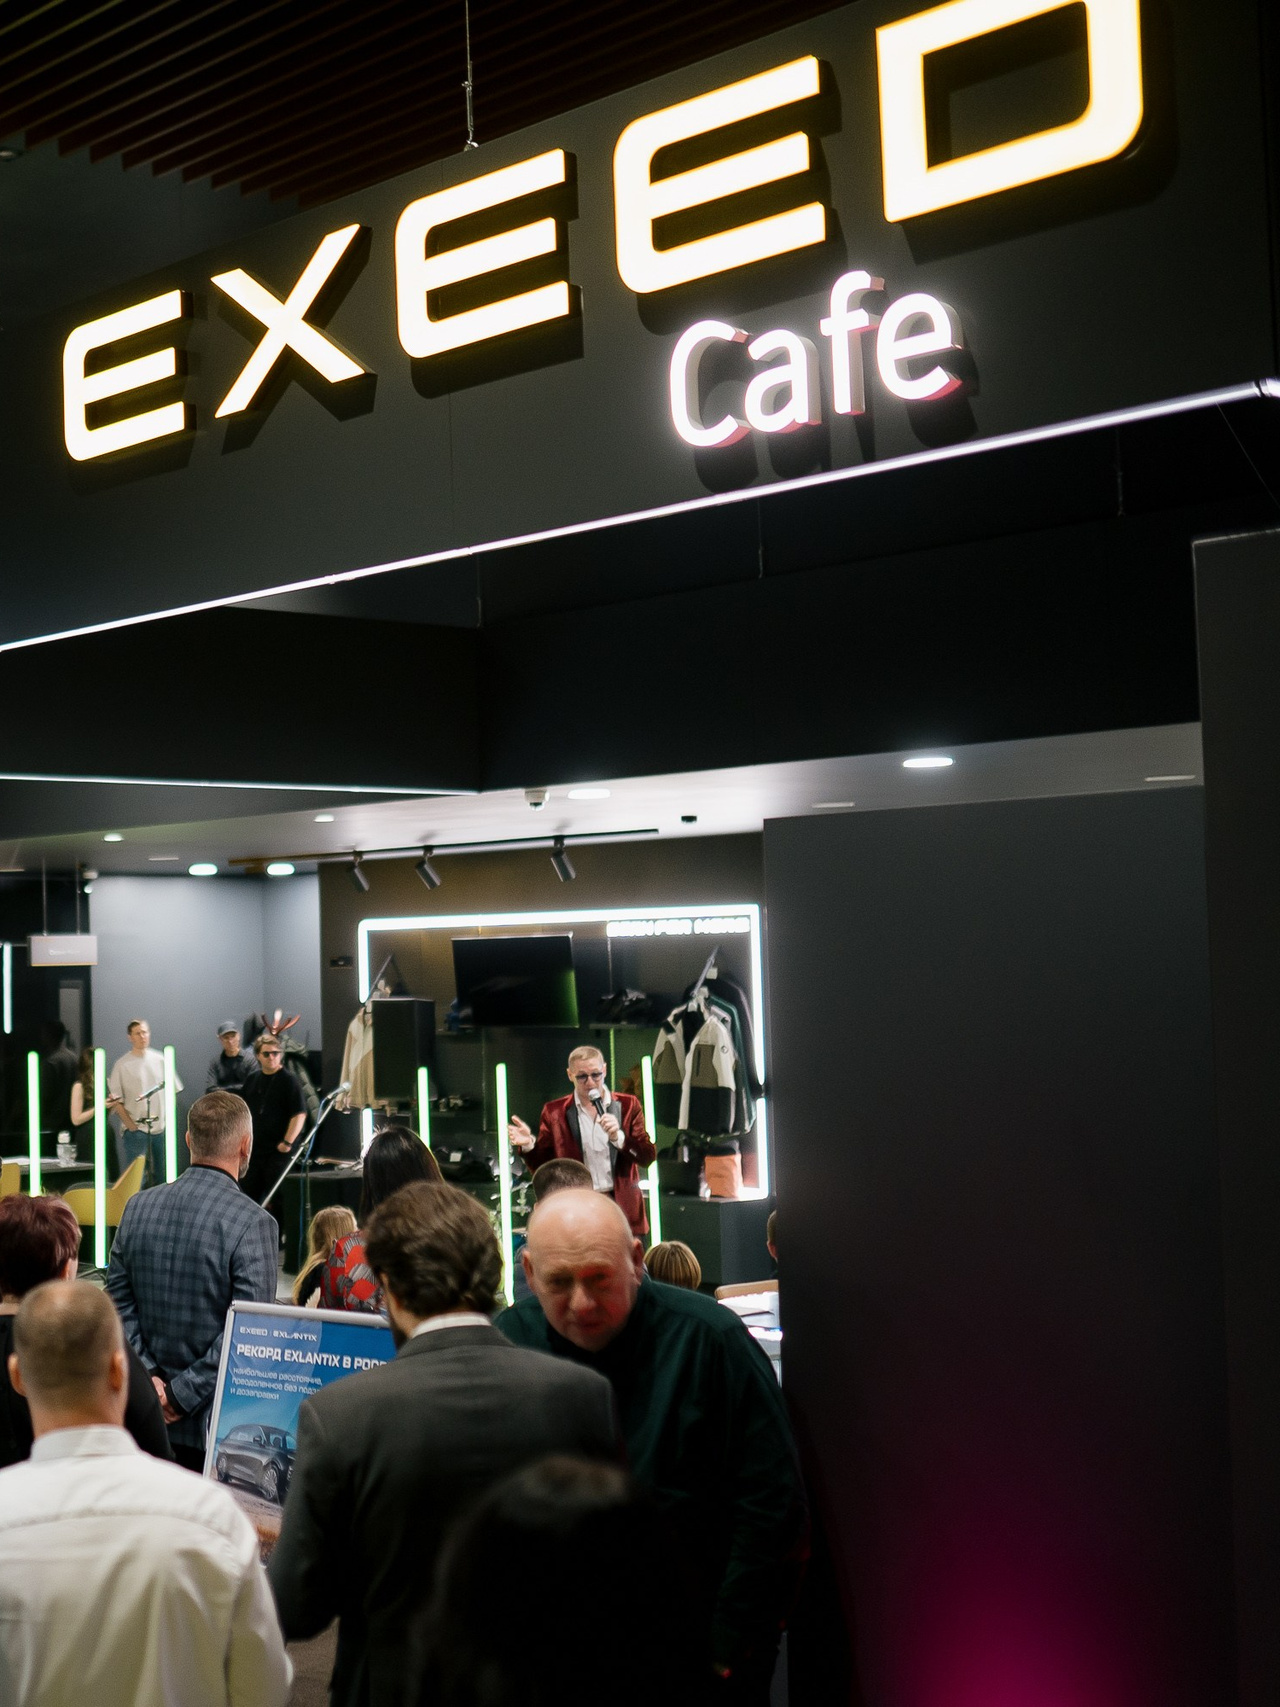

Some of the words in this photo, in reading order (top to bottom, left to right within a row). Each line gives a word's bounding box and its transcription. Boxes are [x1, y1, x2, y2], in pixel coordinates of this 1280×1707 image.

[62, 0, 1144, 461] EXEED
[669, 270, 960, 449] Cafe
[236, 1343, 282, 1362] РЕКОРД
[284, 1348, 340, 1368] EXLANTIX
[343, 1356, 351, 1369] В
[239, 1326, 268, 1336] EXEED
[273, 1330, 317, 1342] EXLANTIX
